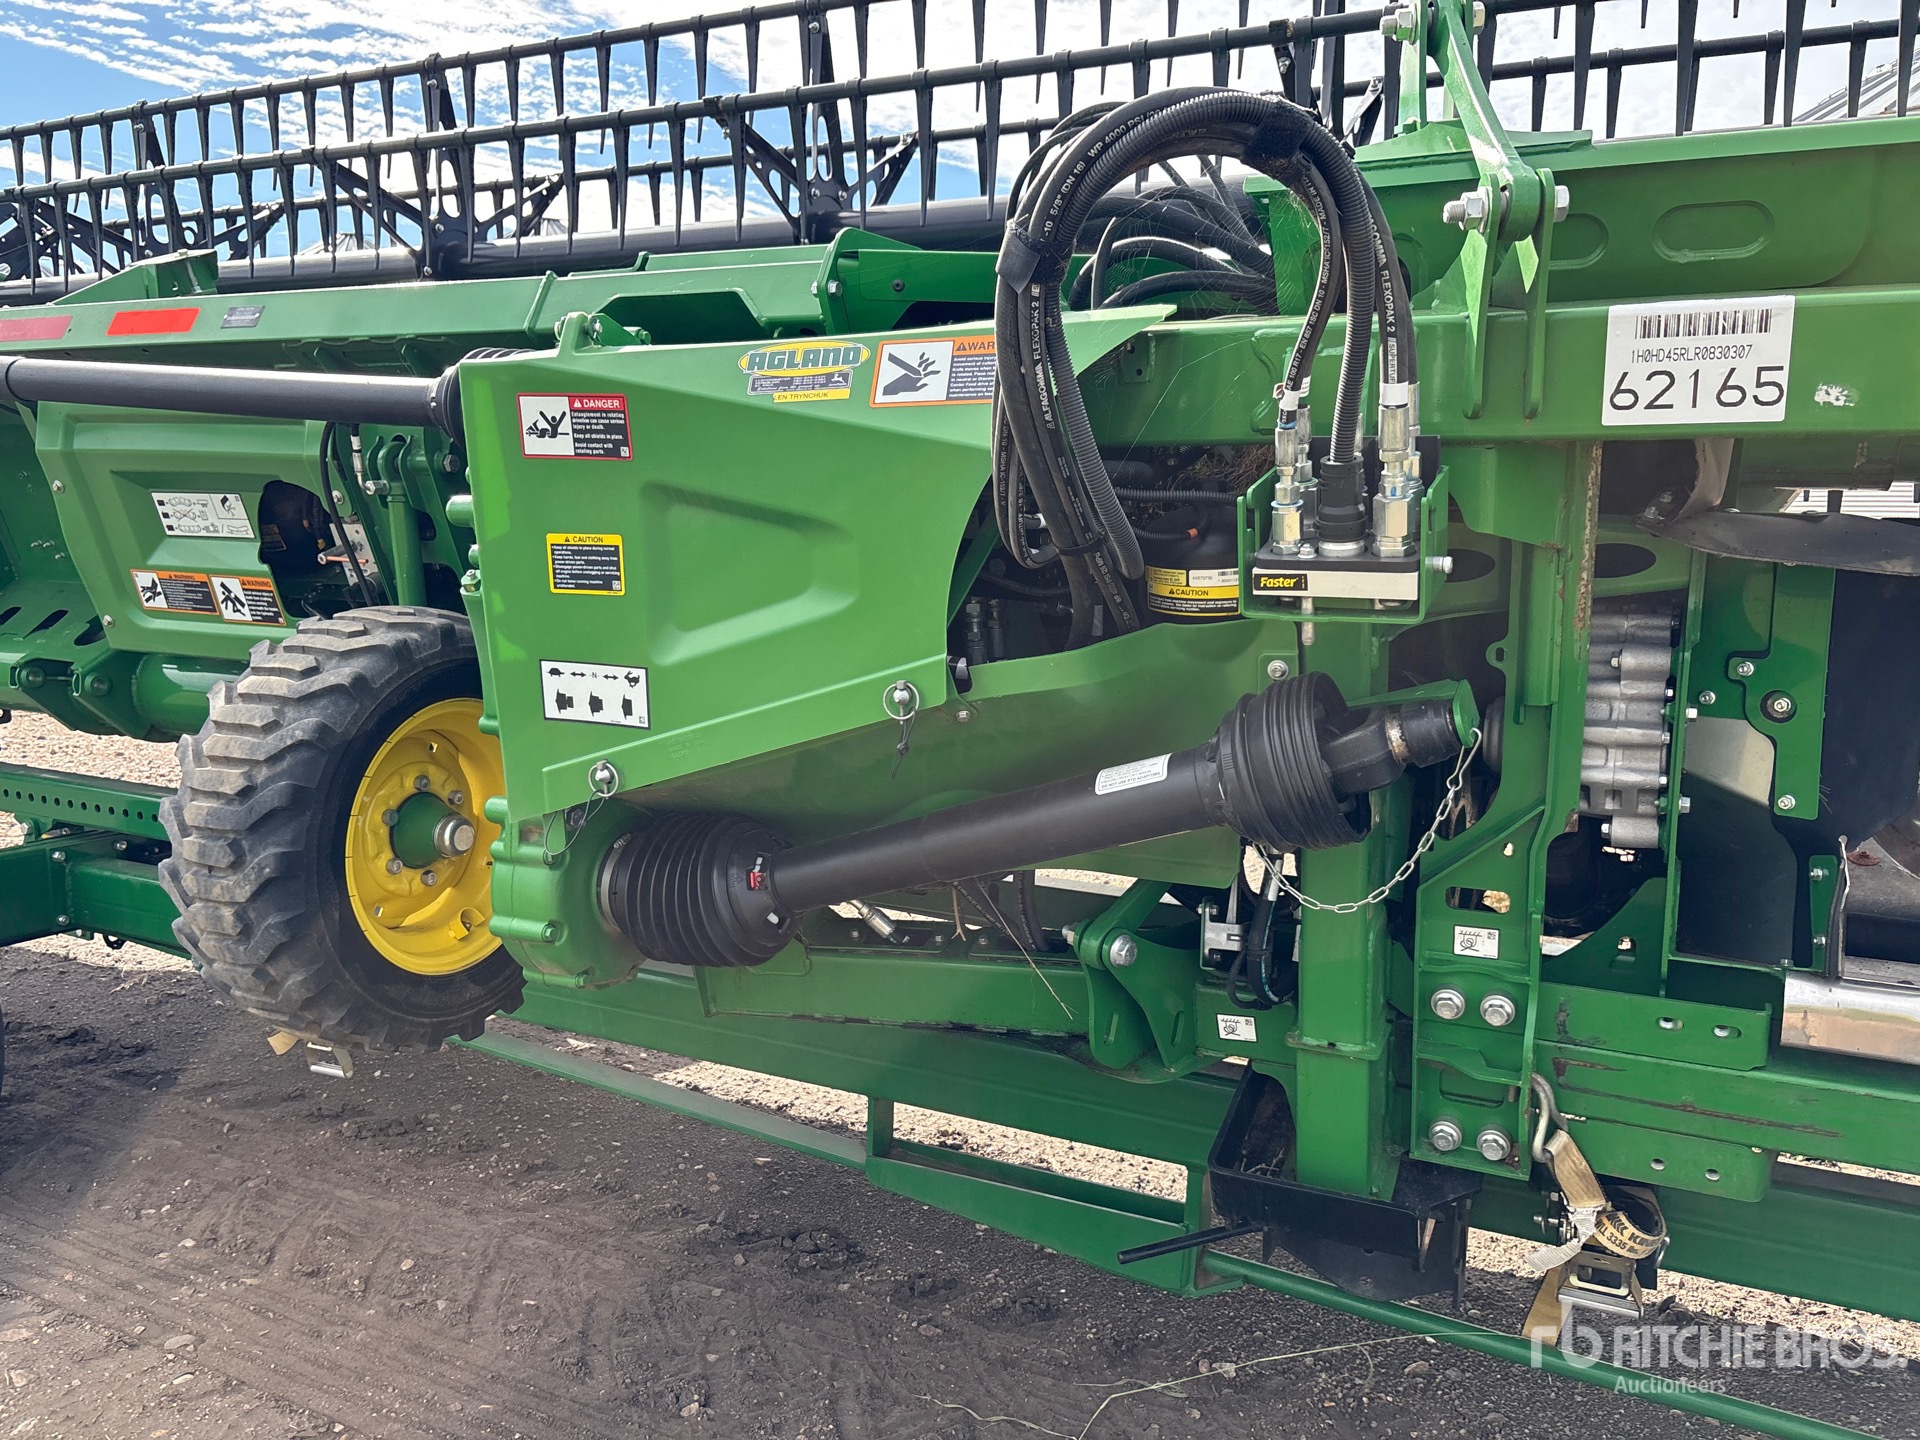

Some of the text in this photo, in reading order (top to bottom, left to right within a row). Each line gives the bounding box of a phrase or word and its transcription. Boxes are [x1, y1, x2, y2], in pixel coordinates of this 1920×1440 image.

[1050, 195, 1062, 216] 5/8"
[1061, 175, 1076, 194] (DN
[1074, 162, 1086, 175] 16)
[1087, 141, 1104, 158] WP
[1104, 124, 1127, 144] 4000
[1380, 270, 1395, 323] FLEXOPAK
[1032, 310, 1041, 359] FLEXOPAK
[1631, 344, 1753, 364] 1H0HD45RLR0830307
[747, 346, 862, 372] AGLAND
[1388, 343, 1396, 384] SUPERTUF
[583, 400, 620, 408] DANGER
[1035, 362, 1052, 421] ALFAGOMMA
[1609, 366, 1785, 411] 62165
[1260, 577, 1297, 587] Faster
[1606, 1232, 1628, 1250] 3335
